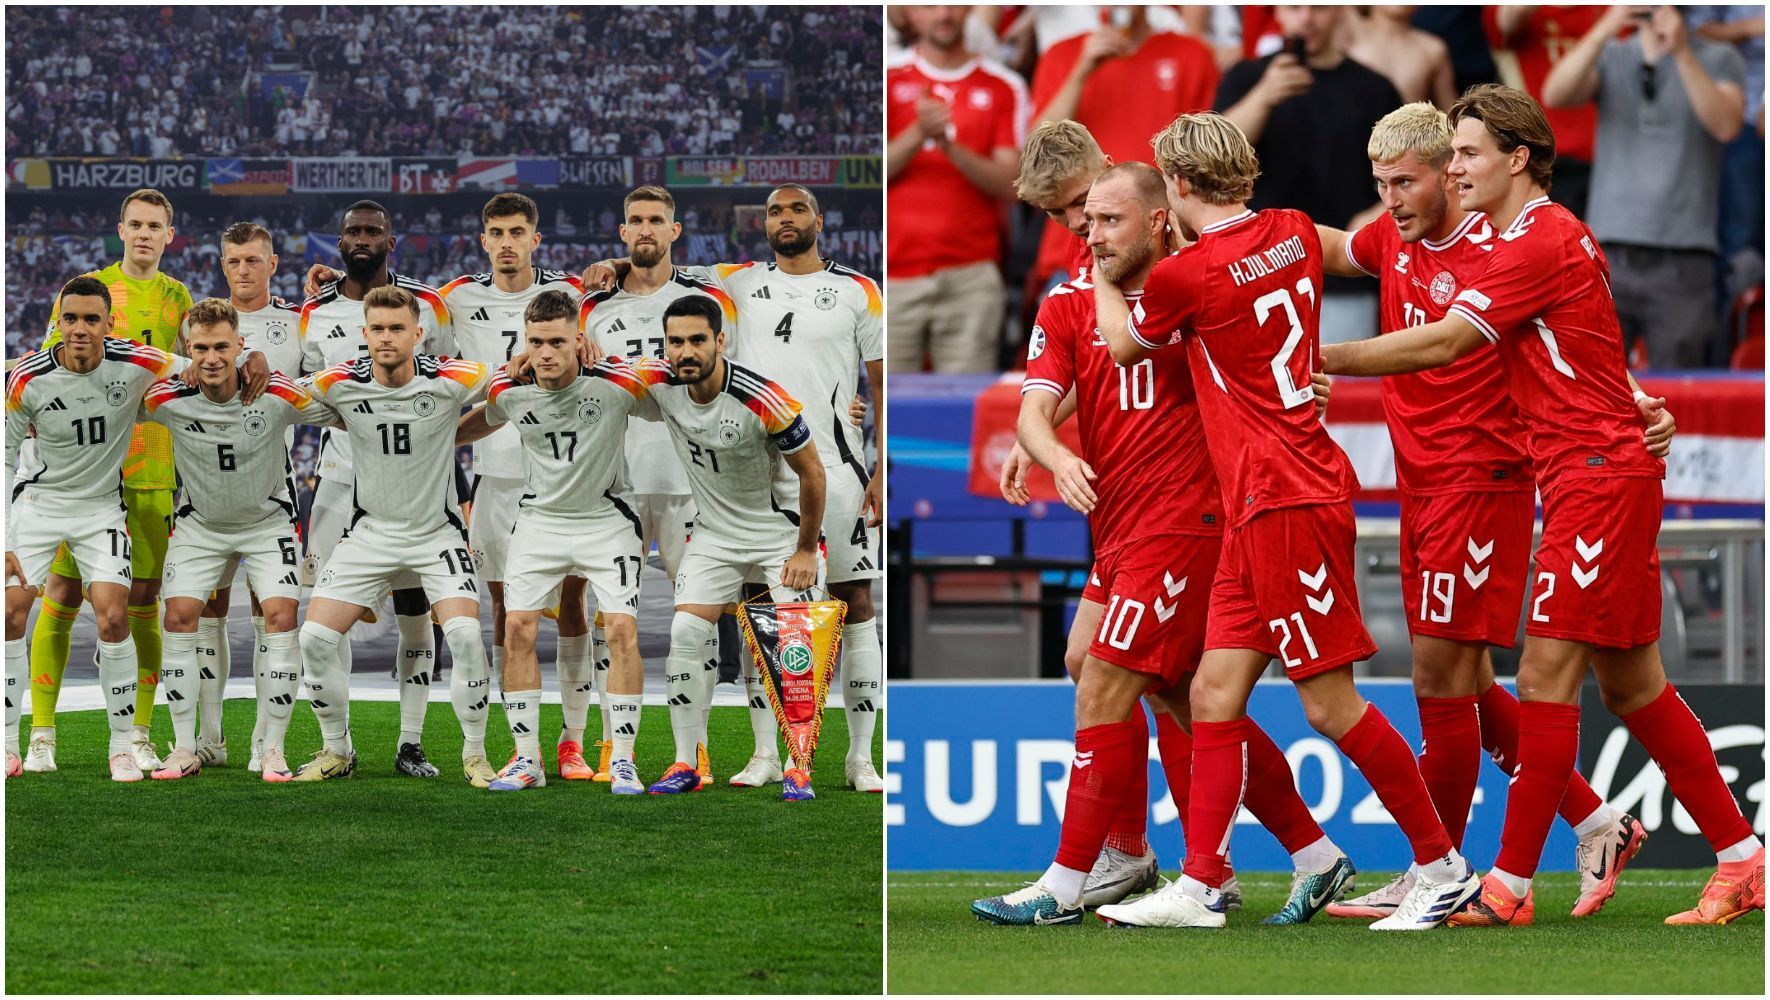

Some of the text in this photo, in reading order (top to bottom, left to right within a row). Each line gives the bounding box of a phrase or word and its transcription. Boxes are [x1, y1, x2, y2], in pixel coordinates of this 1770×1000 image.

[56, 164, 195, 187] HARZBURG
[399, 163, 428, 193] BT
[749, 160, 830, 181] RODALBEN
[1228, 235, 1306, 286] HJULMAND
[774, 312, 794, 344] 4
[501, 331, 518, 361] 7
[1115, 358, 1154, 411] 10
[71, 416, 107, 446] 10
[376, 423, 413, 455] 18
[217, 444, 237, 472] 6
[544, 431, 577, 463] 17
[687, 439, 720, 473] 21
[850, 517, 868, 549] 4
[277, 537, 297, 566] 6
[439, 548, 475, 575] 18
[613, 555, 642, 588] 17
[1420, 571, 1456, 623] 19
[1532, 571, 1556, 623] 2
[1098, 595, 1146, 651] 10
[196, 646, 216, 656] FB
[406, 650, 433, 659] DFB
[1269, 611, 1320, 668] 21
[270, 670, 298, 681] DFB
[849, 680, 878, 689] DFB
[612, 703, 637, 712] DFB
